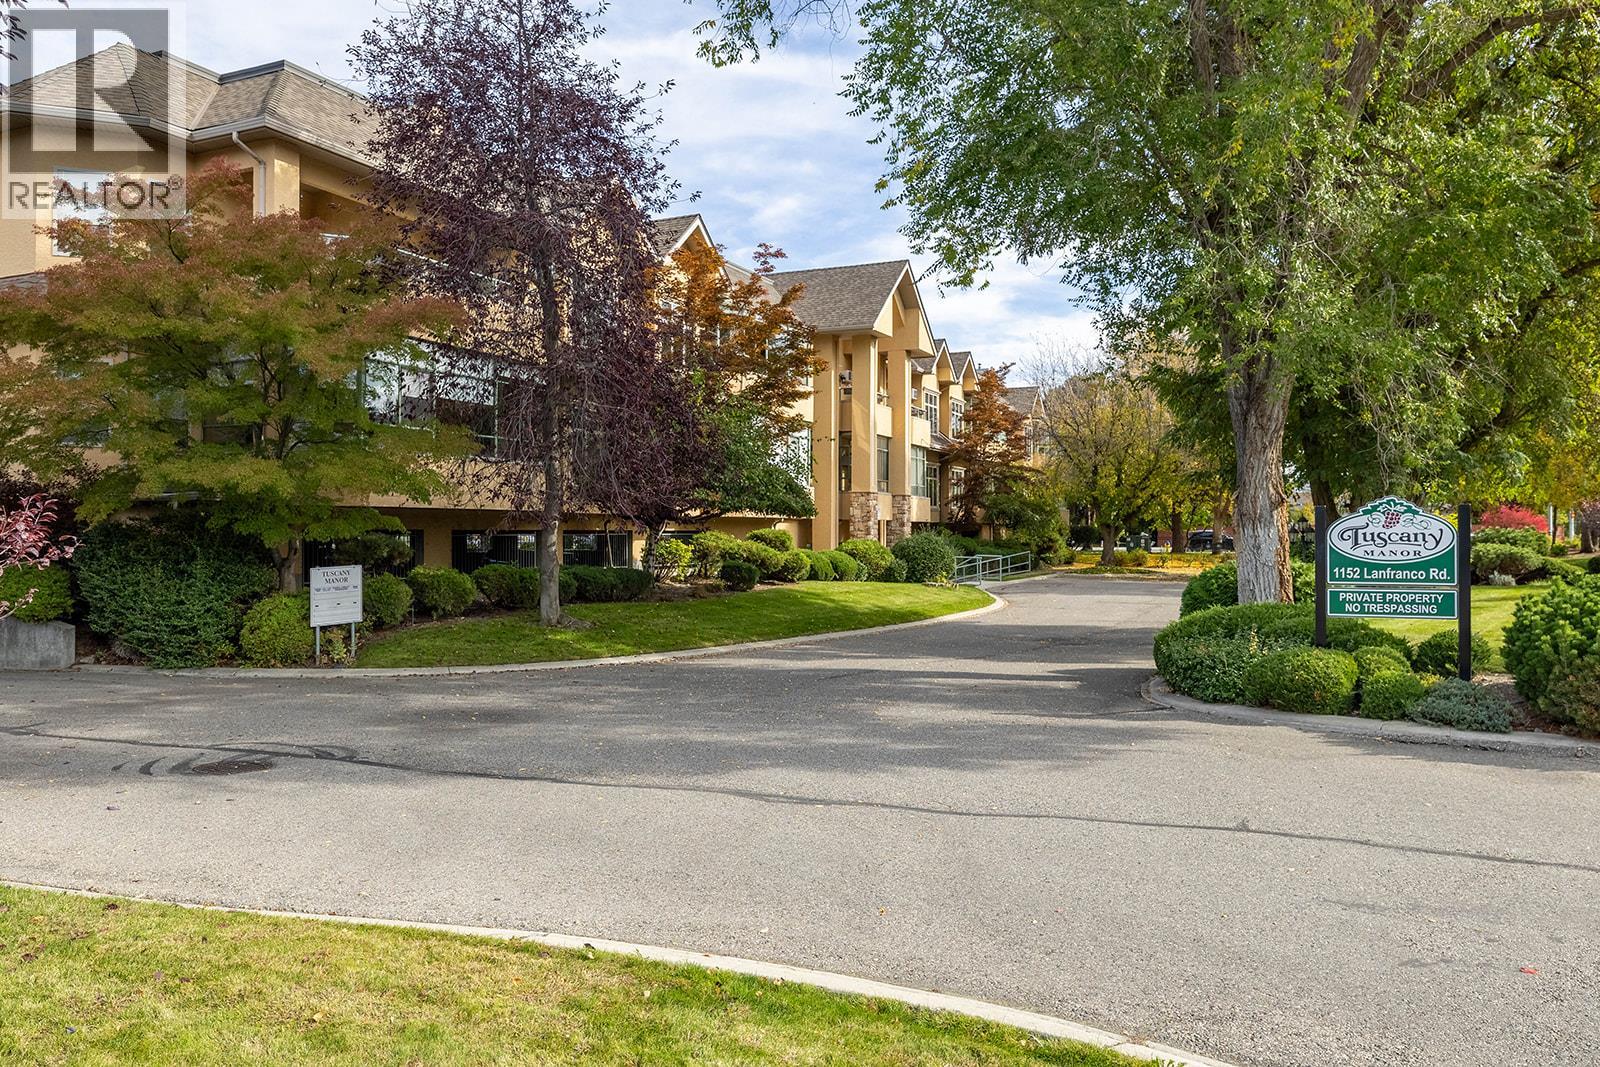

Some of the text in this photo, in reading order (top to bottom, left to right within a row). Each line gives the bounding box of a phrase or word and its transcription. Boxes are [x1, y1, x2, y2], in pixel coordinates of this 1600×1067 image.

[1338, 522, 1444, 551] Tuscany
[1363, 549, 1422, 557] MANOR
[322, 569, 351, 577] TUSCANY
[1333, 567, 1451, 580] 1152 Lanfranco Rd.
[324, 577, 349, 585] MANOR
[1339, 592, 1444, 603] PRIVATE PROPERTY
[1345, 603, 1438, 614] NO TRESPASSING
